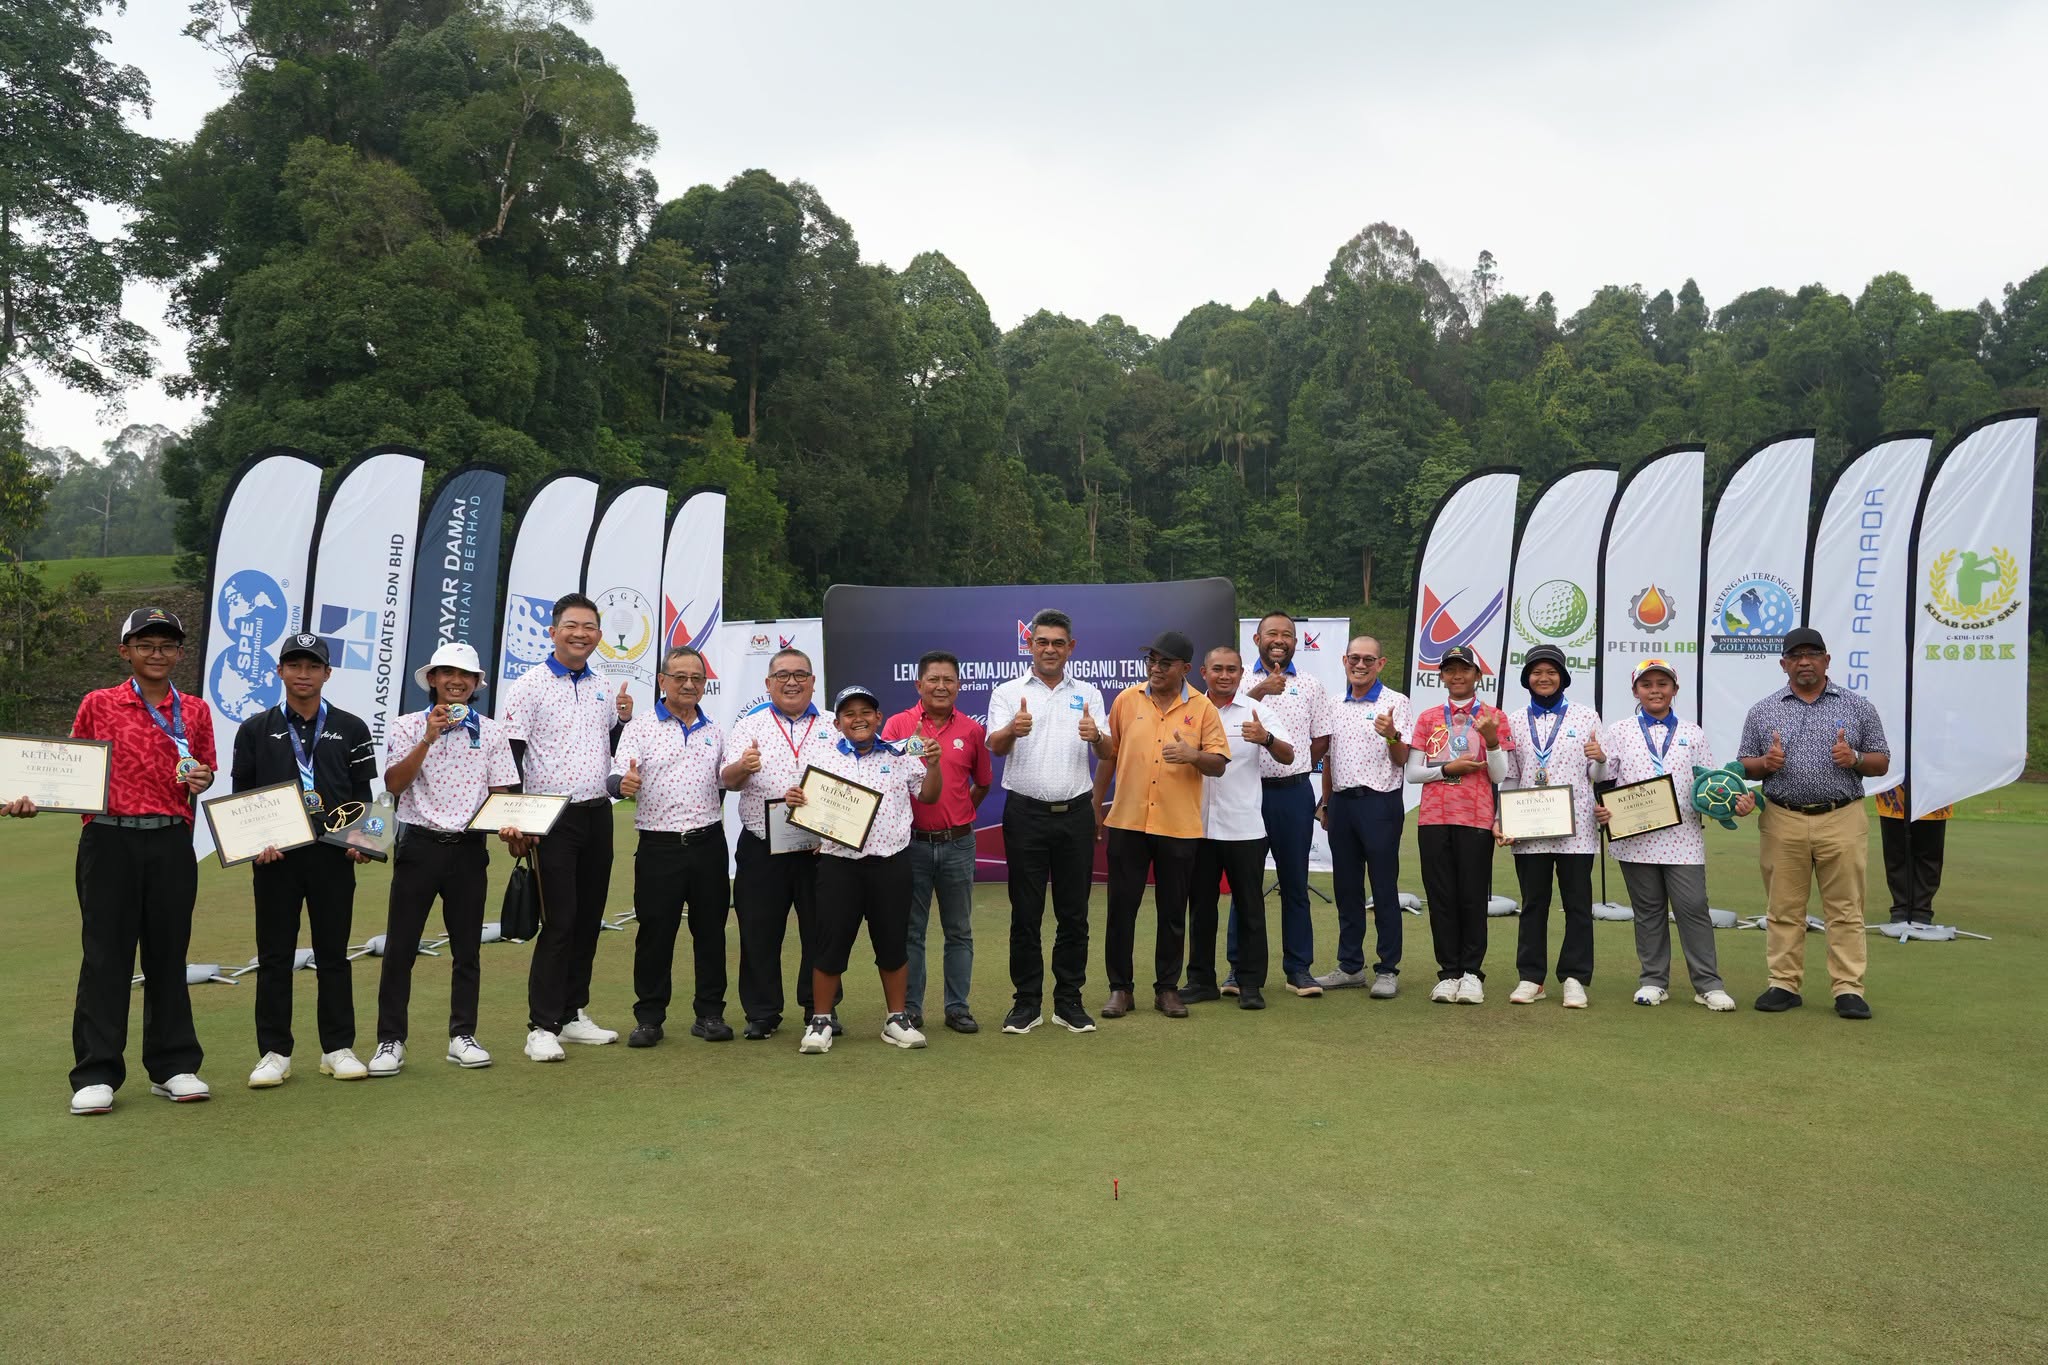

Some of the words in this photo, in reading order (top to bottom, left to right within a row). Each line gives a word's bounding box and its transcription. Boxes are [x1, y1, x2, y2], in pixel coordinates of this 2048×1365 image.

[389, 533, 405, 568] BHD
[444, 498, 466, 571] DAMAI
[463, 495, 481, 572] BERHAD
[1852, 488, 1885, 634] ARMADA
[385, 572, 400, 607] SDN
[1713, 574, 1750, 614] KETENGAH
[1752, 572, 1801, 613] TERENGGANU
[290, 605, 301, 636] ECTION
[1923, 602, 1959, 629] KELAB
[1961, 618, 1995, 630] GOLF
[1997, 600, 2022, 622] SRK
[237, 621, 254, 670] SPE
[250, 617, 264, 679] International
[375, 610, 396, 706] ASSOCIATES
[1607, 641, 1697, 654] PETROLAB
[1719, 643, 1746, 652] GOLF
[1925, 643, 2016, 661] KGSRK
[958, 661, 1027, 680] KEMAJUAN
[373, 710, 387, 747] HHA
[21, 750, 82, 762] KETENGAH
[820, 783, 860, 805] KETENGAH
